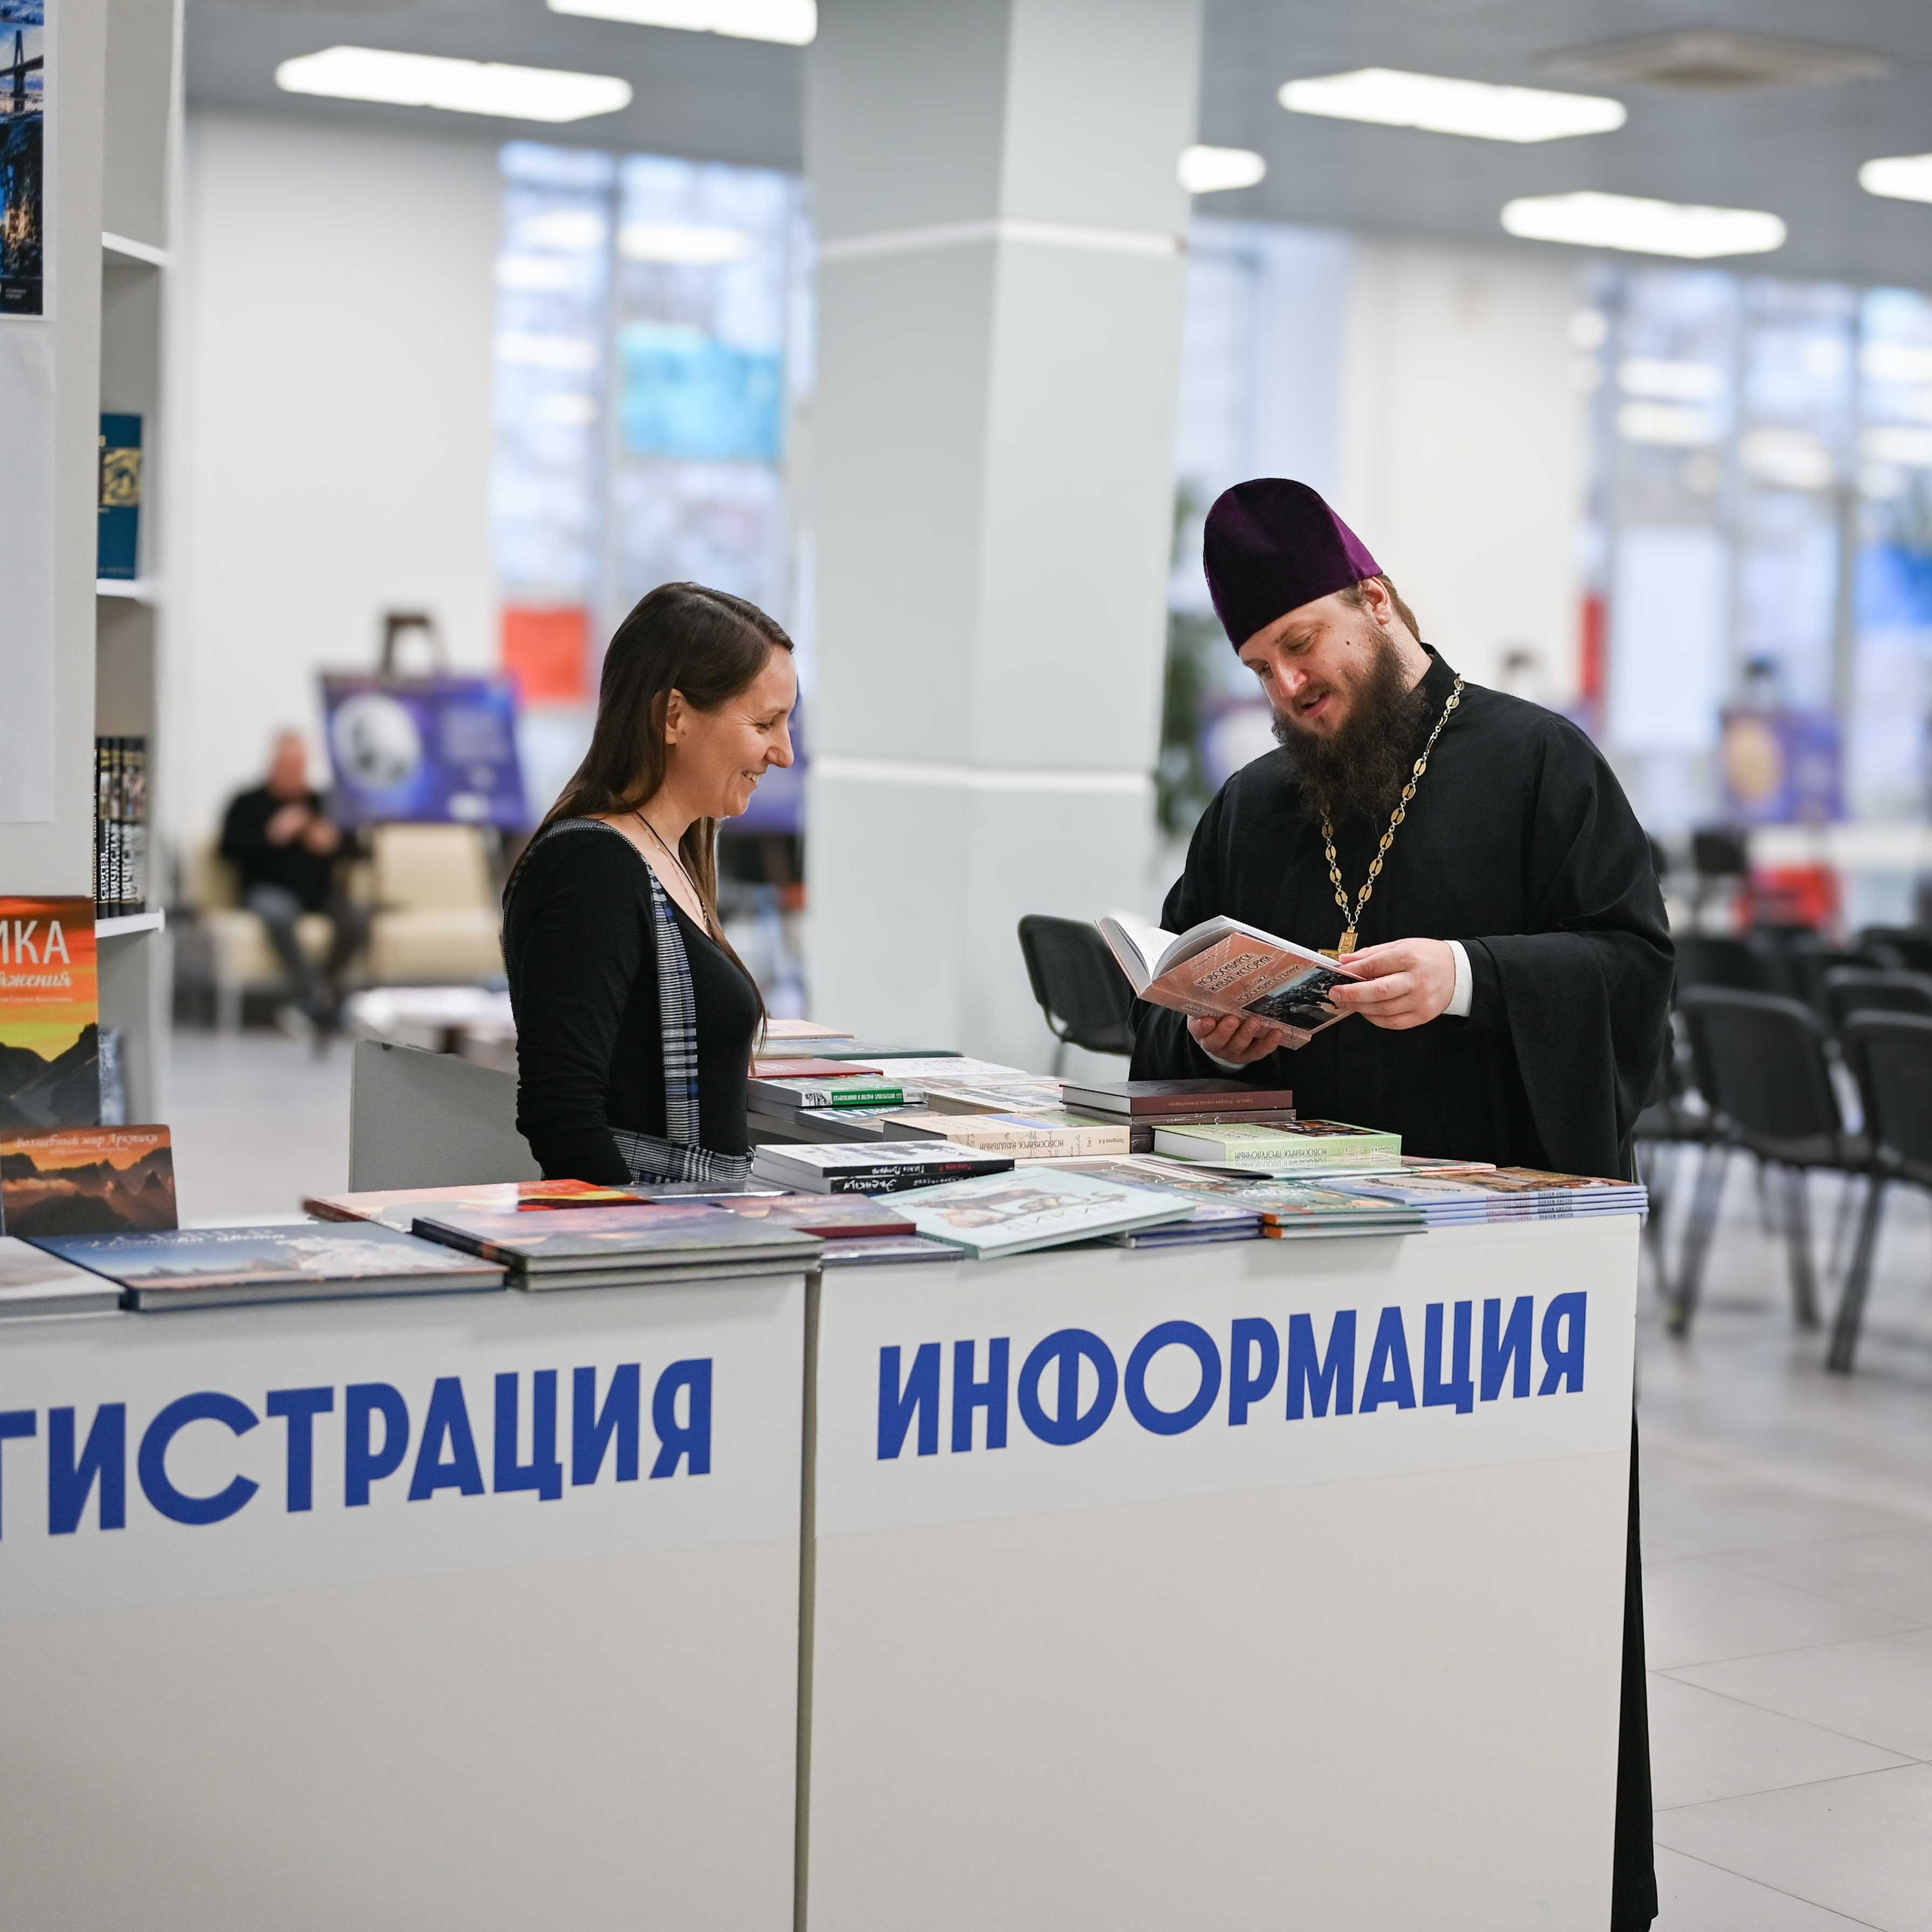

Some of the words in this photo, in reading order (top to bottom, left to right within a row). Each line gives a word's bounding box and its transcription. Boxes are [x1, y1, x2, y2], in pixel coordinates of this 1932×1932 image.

[110, 823, 121, 899] ВЯЧЕСЛАВ
[1208, 975, 1238, 993] ЖИВАЯ
[1235, 955, 1274, 979] ИСТОРИЯ
[979, 1140, 1017, 1152] НАЧАЛЬНЫЙ
[1017, 1140, 1065, 1150] НОВОСИБИРСК
[1235, 1149, 1282, 1161] ПРОГУЛОЧНЫЙ
[1283, 1147, 1327, 1158] НОВОСИБИРСК
[876, 1291, 1587, 1460] ИНФОРМАЦИЯ
